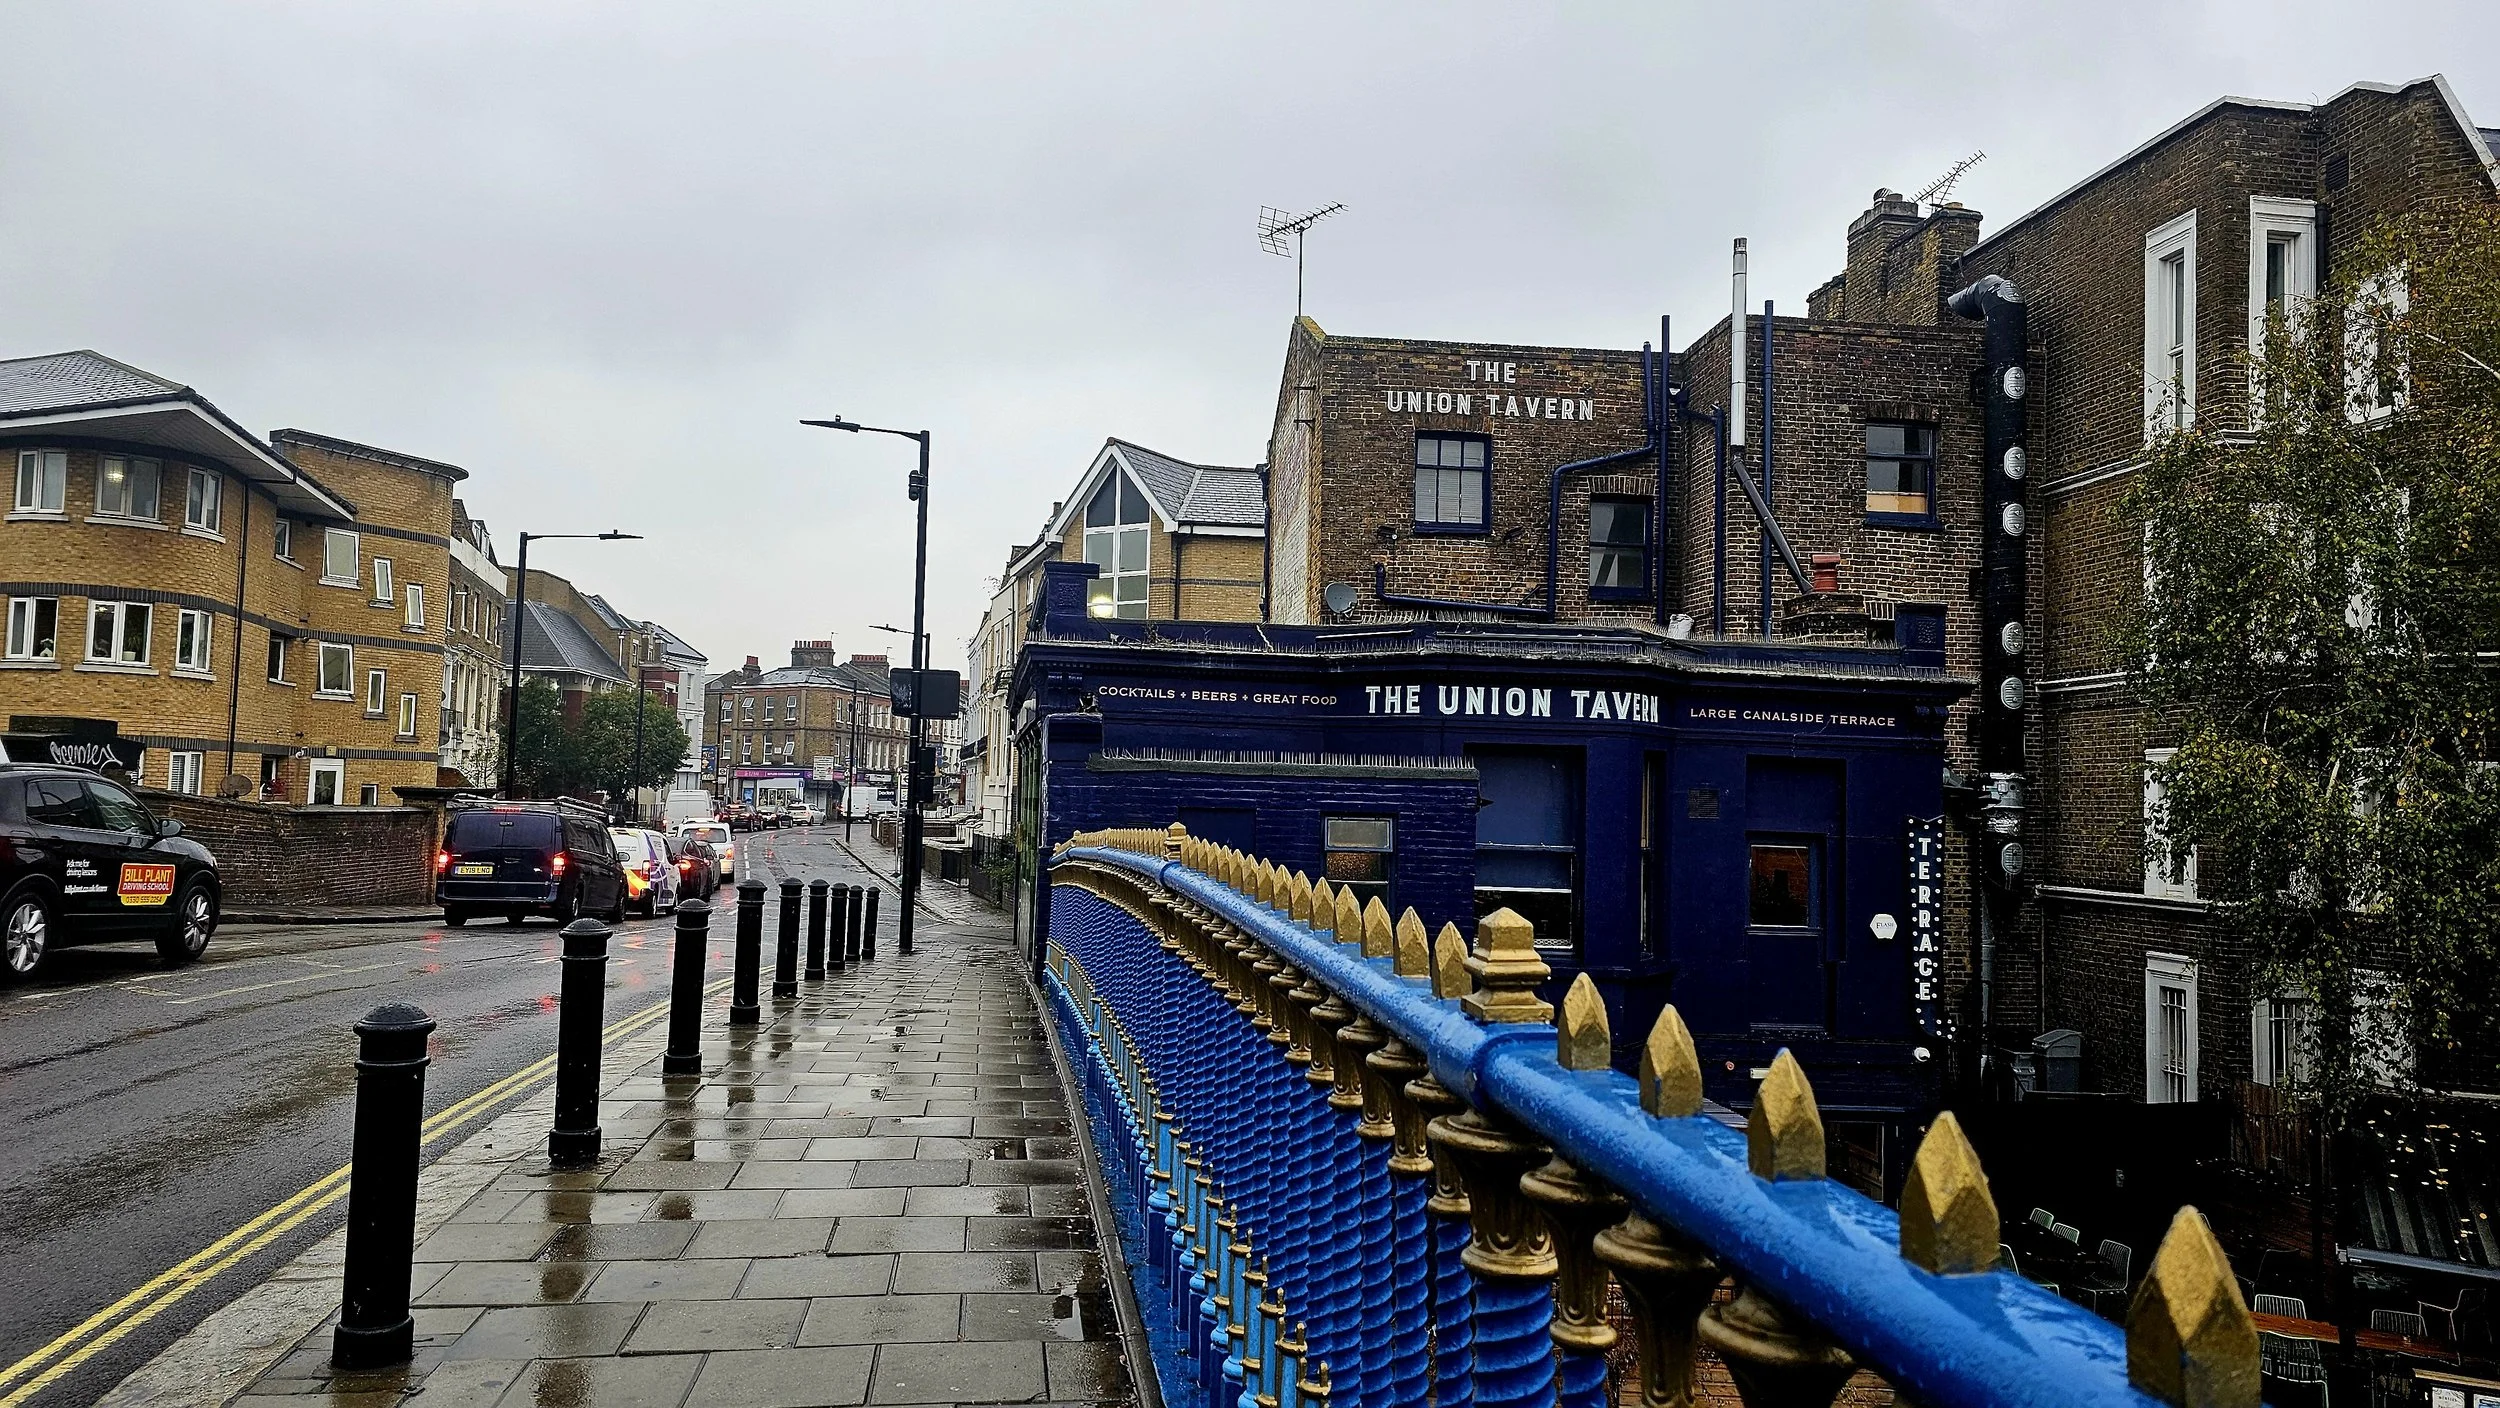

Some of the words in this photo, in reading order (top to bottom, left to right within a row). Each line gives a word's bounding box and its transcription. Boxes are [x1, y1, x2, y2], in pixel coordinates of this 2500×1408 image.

[1466, 359, 1517, 384] THE
[1386, 390, 1471, 416] UNION
[1485, 393, 1594, 421] TAVERN
[1098, 686, 1176, 699] COCKTAILS
[1191, 690, 1238, 702] BEERS
[1252, 693, 1298, 704] GREAT
[1301, 695, 1338, 706] FOOD
[1365, 685, 1421, 714] THE
[1438, 685, 1552, 717] UNION
[1570, 689, 1659, 723] TAVERN
[1690, 708, 1737, 719] LARGE
[1742, 710, 1824, 724] CANALSIDE
[1830, 714, 1896, 727] TERRACE
[122, 882, 147, 891] DRIVING
[147, 883, 170, 891] SCHOOL
[124, 868, 143, 882] BILL
[144, 869, 172, 883] PLANT
[1918, 837, 1933, 1001] TERRACE
